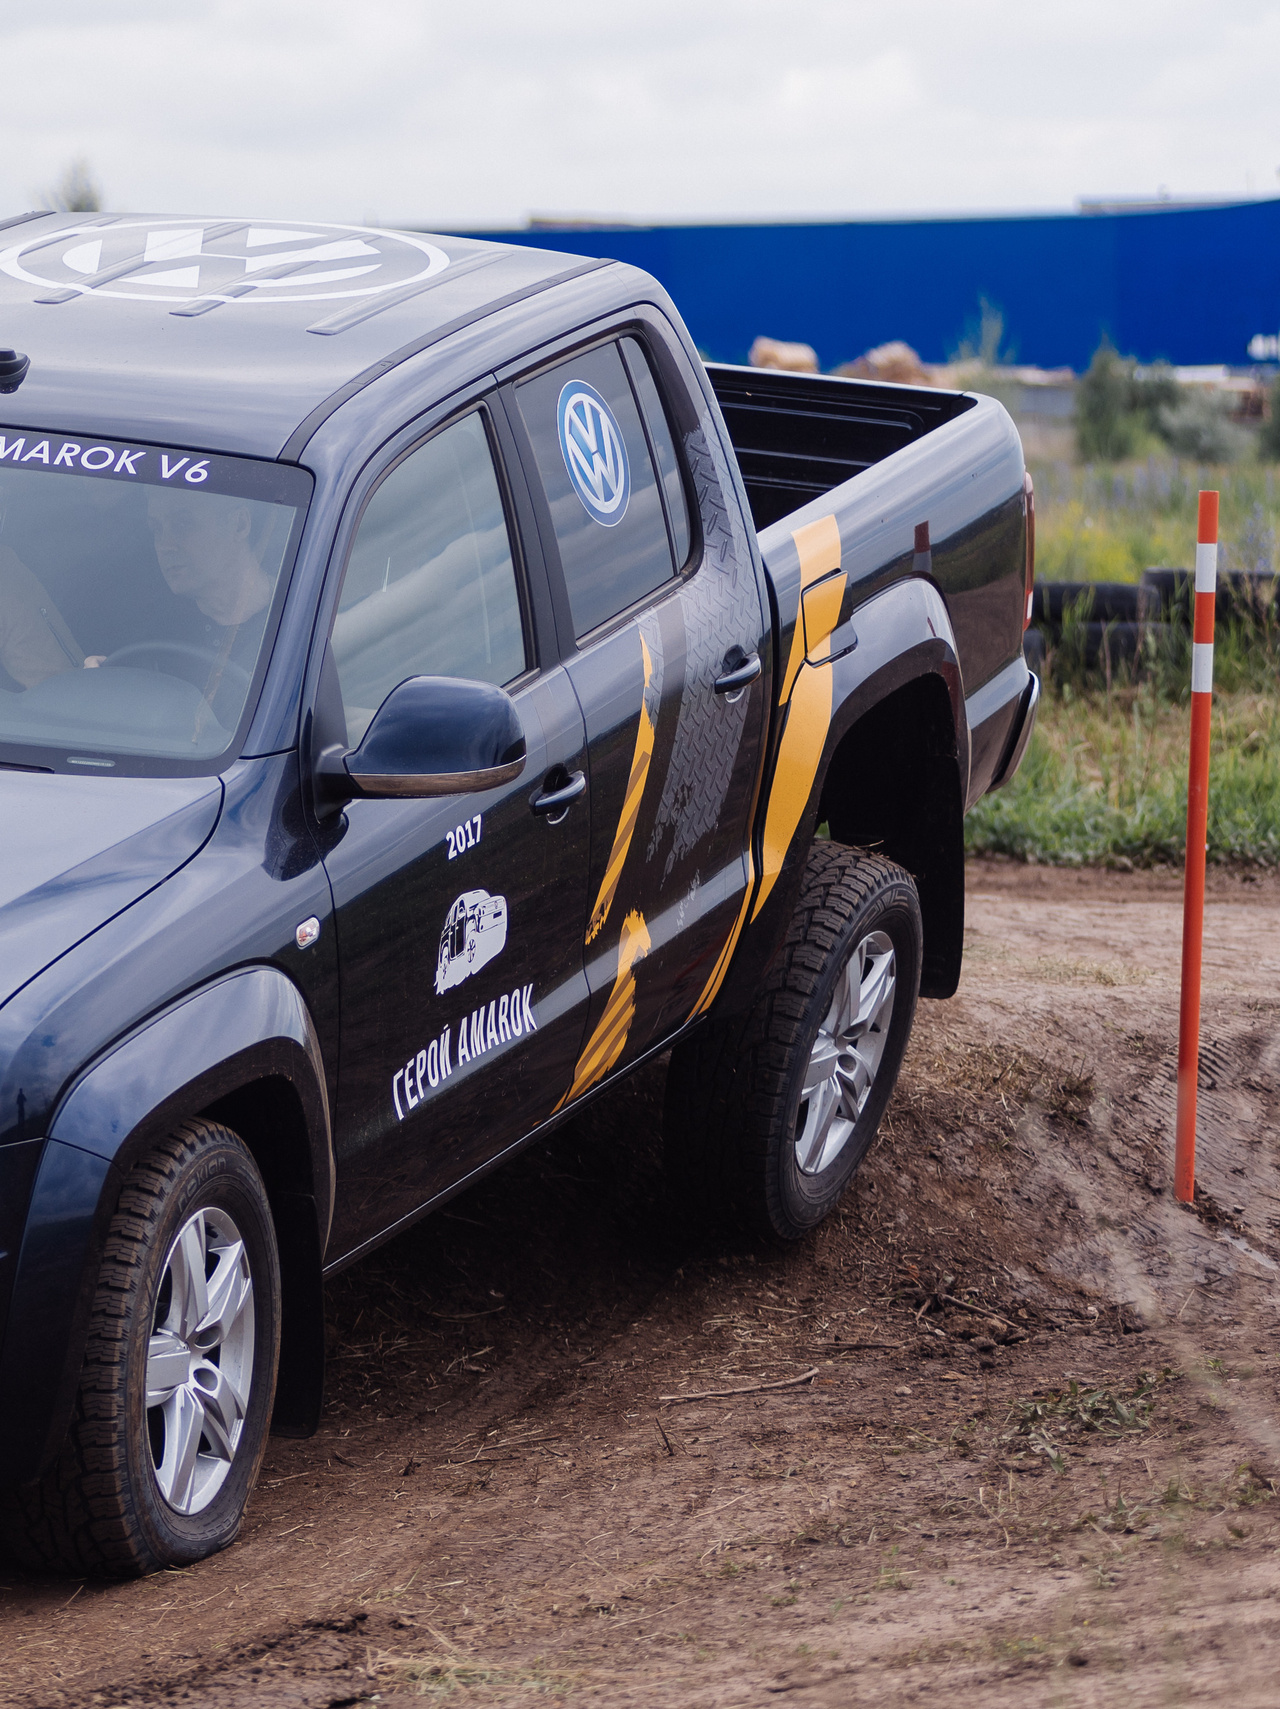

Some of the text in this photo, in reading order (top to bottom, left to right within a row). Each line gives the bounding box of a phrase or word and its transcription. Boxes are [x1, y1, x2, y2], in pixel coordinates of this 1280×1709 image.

[159, 455, 209, 484] V6
[446, 814, 482, 860] 2017
[393, 984, 538, 1121] ГЕРОЙ AMAROK
